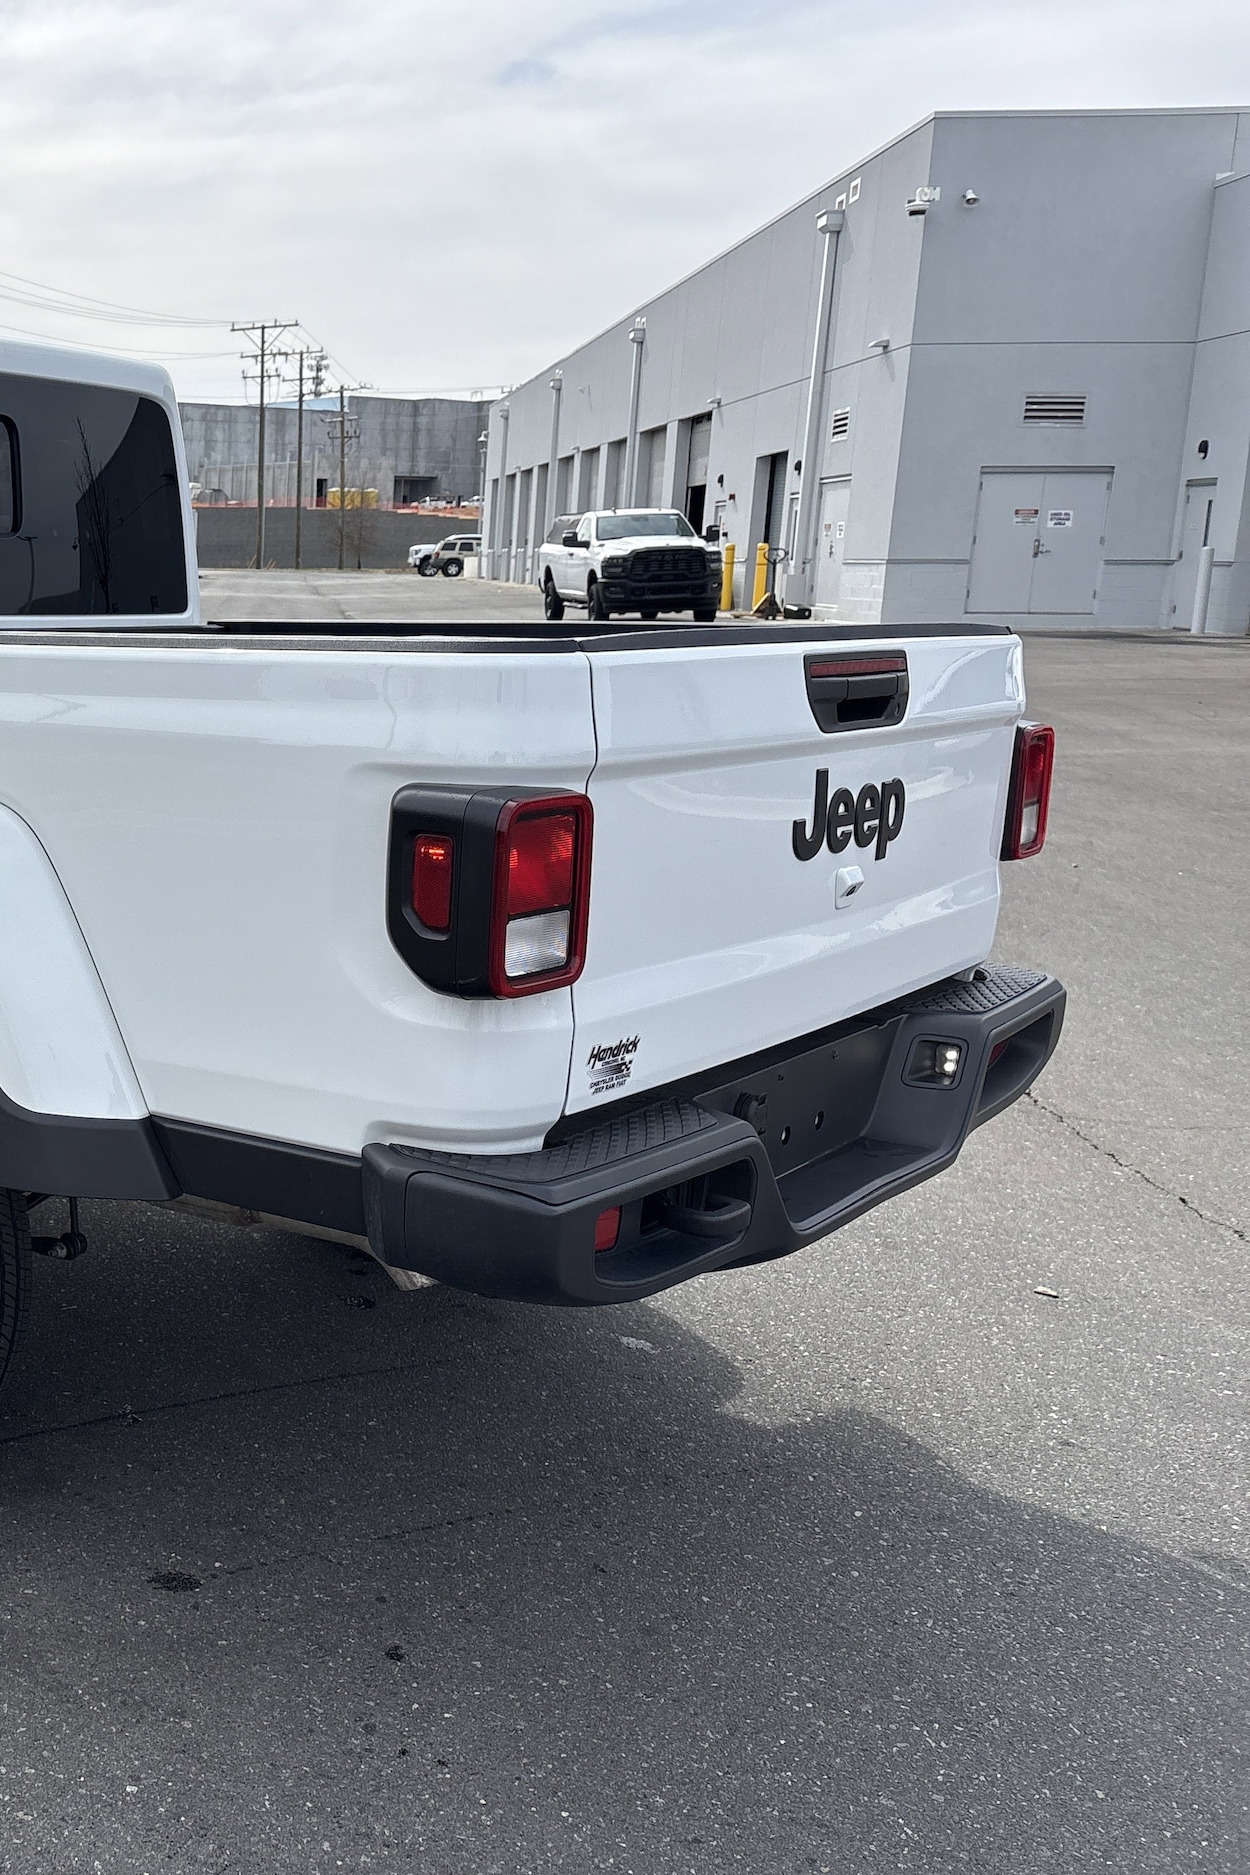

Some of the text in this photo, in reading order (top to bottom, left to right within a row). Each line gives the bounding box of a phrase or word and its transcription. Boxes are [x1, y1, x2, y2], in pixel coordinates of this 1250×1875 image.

[792, 768, 905, 861] Jeep
[587, 1035, 641, 1069] Hendrick
[590, 1071, 631, 1089] CHRYSLER DODGE
[592, 1079, 627, 1095] JEEP RAM FIAT
